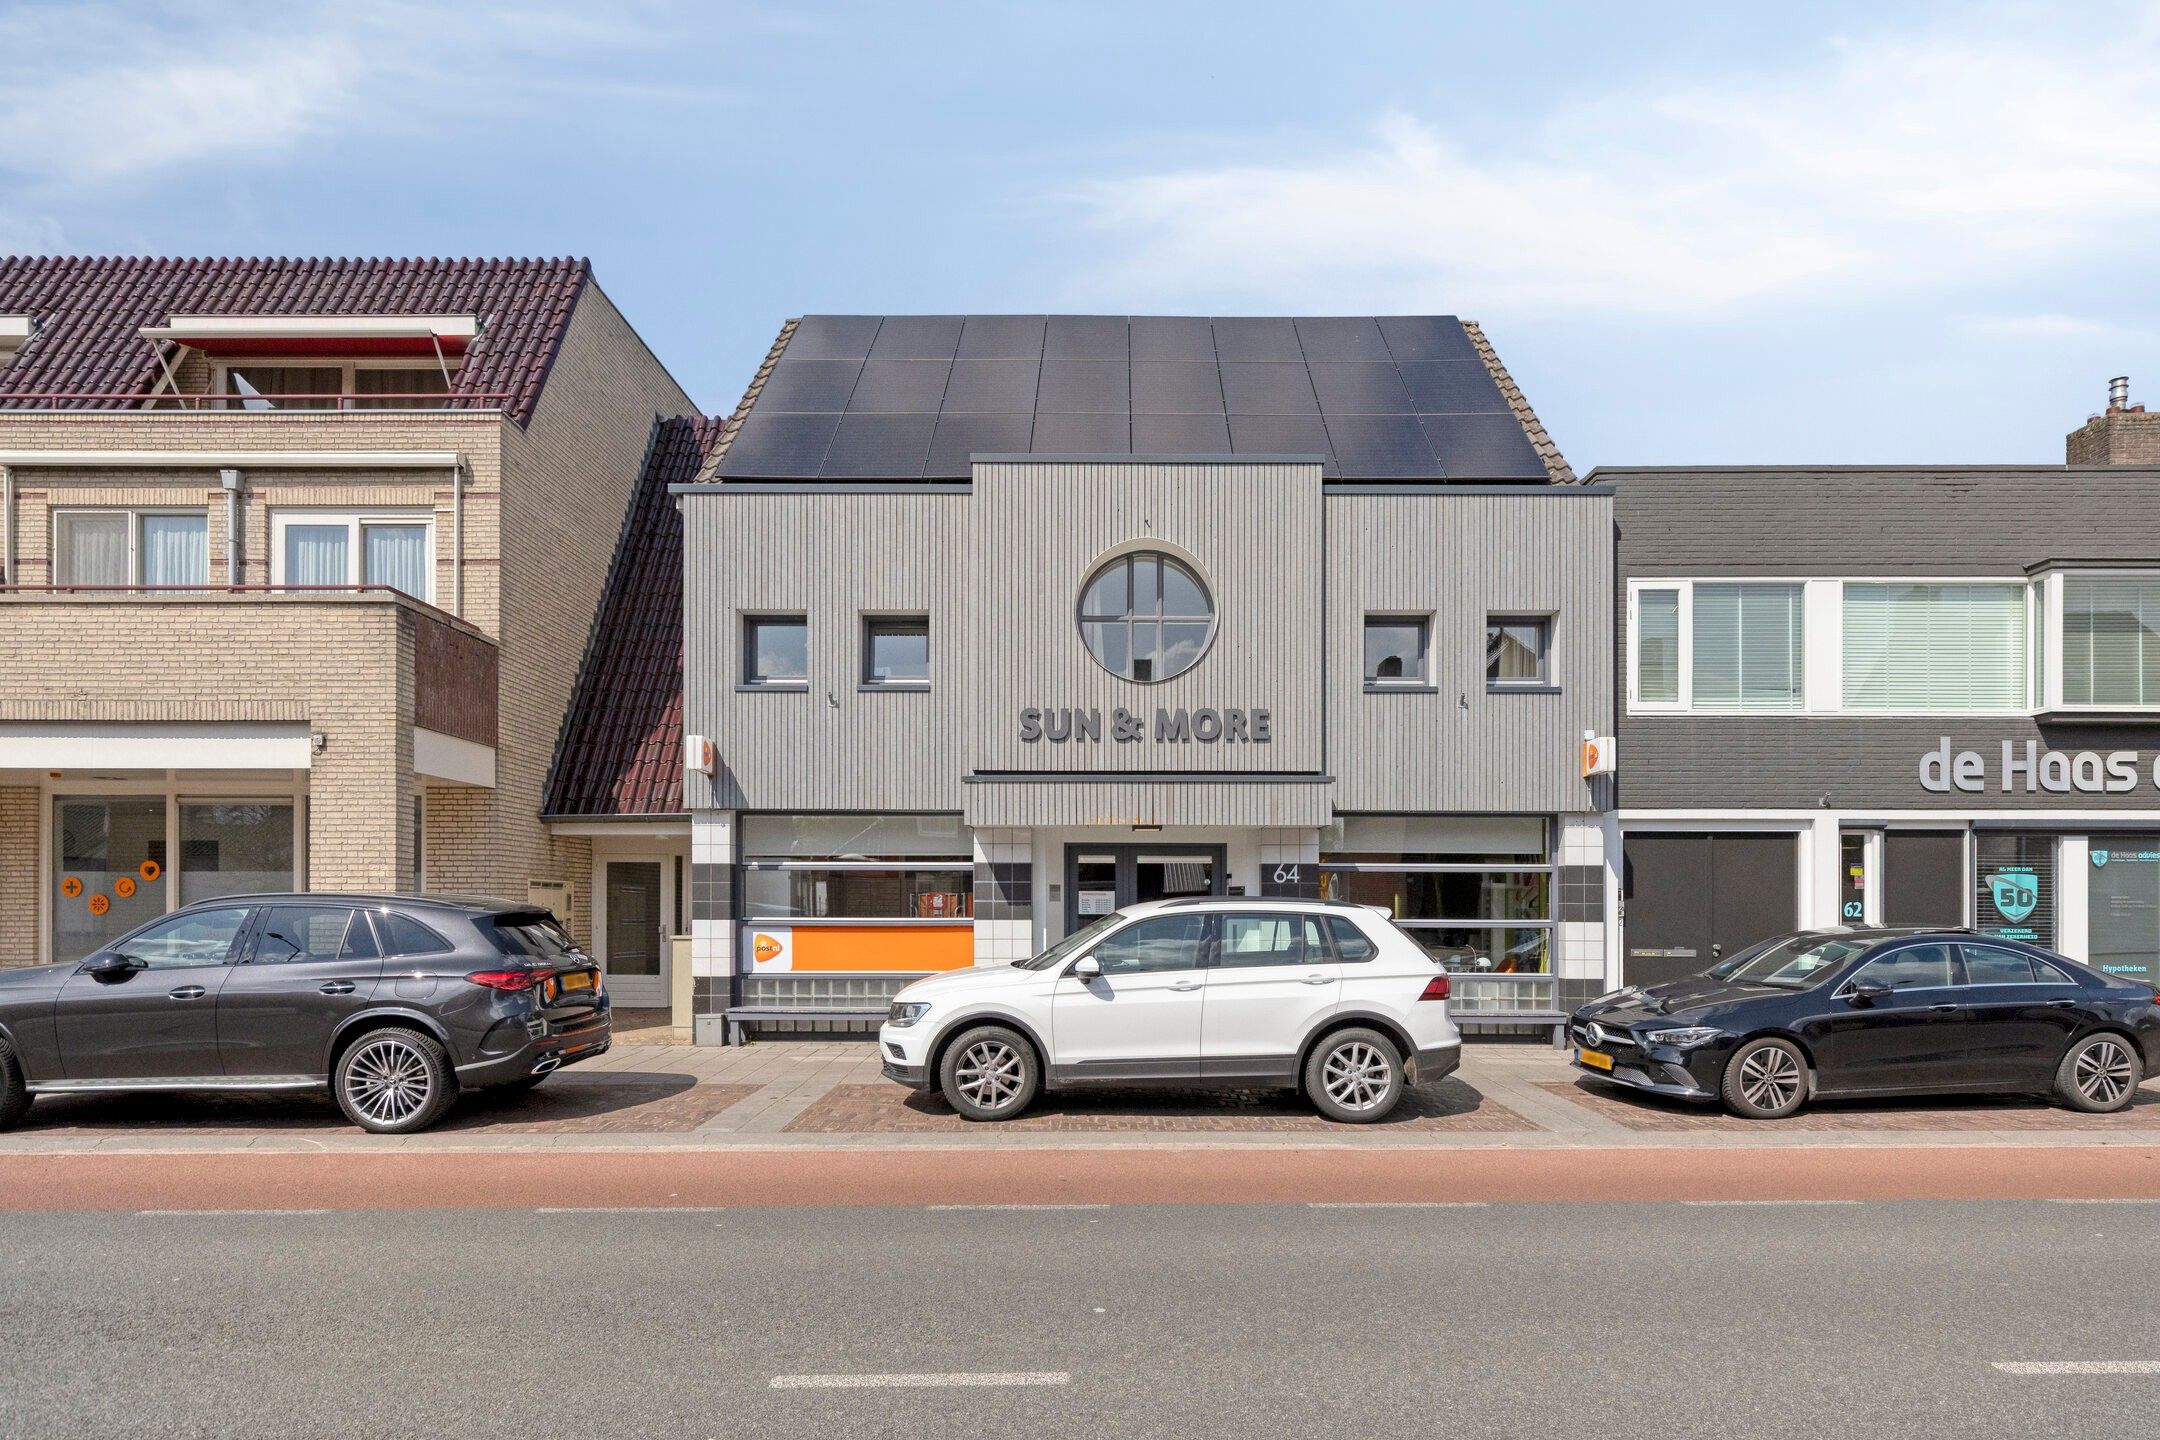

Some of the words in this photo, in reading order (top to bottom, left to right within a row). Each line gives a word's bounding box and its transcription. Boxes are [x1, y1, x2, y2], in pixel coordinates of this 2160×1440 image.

[1019, 707, 1101, 743] SUN
[1111, 707, 1143, 743] &
[1155, 707, 1271, 743] MORE
[1918, 736, 1985, 792] de
[2001, 740, 2138, 792] Haas
[2111, 851, 2120, 859] de
[2120, 851, 2138, 859] Haas
[1273, 863, 1300, 884] 64
[2000, 888, 2033, 908] 50
[1843, 901, 1862, 918] 62
[756, 945, 780, 953] postnl
[2102, 964, 2147, 974] Hypotheken
